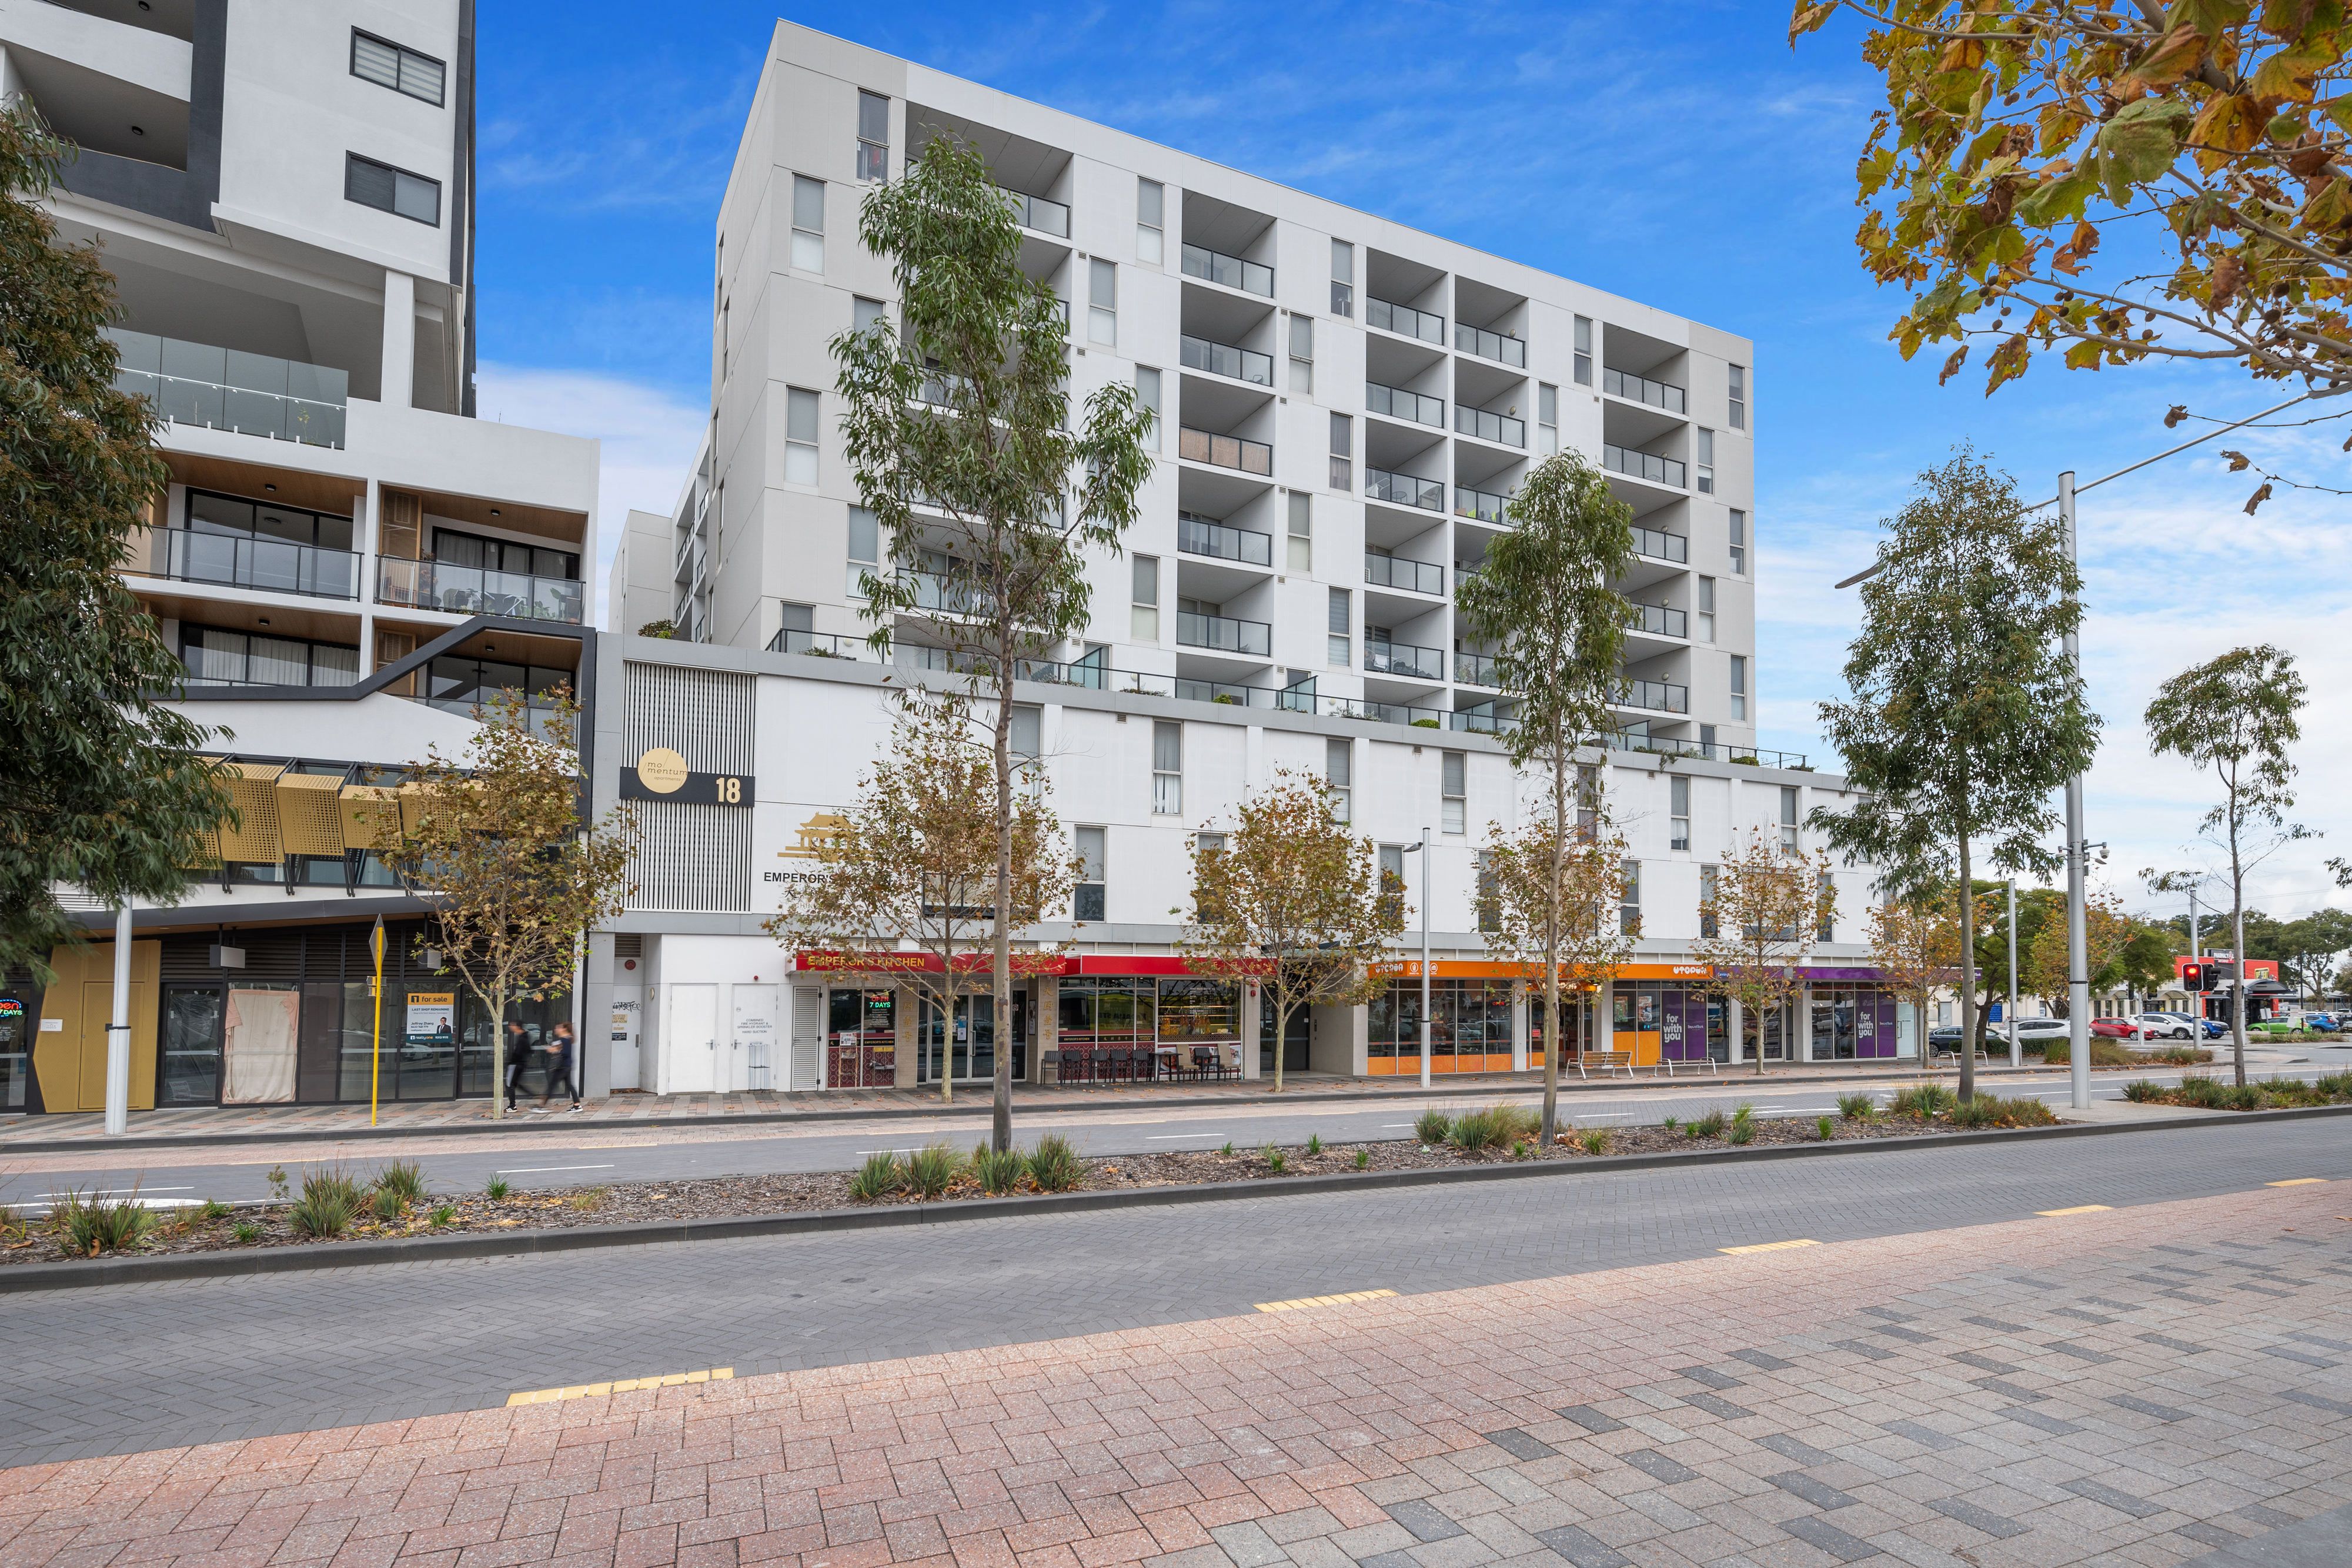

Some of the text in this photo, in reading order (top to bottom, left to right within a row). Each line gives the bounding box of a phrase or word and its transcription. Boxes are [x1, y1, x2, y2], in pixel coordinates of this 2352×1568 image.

[647, 767, 687, 775] mentum
[716, 777, 741, 804] 18
[1666, 1013, 1679, 1023] for
[1860, 1011, 1870, 1020] for
[1663, 1023, 1682, 1033] with
[1857, 1021, 1873, 1029] with
[1664, 1033, 1681, 1043] you
[1859, 1029, 1873, 1038] you
